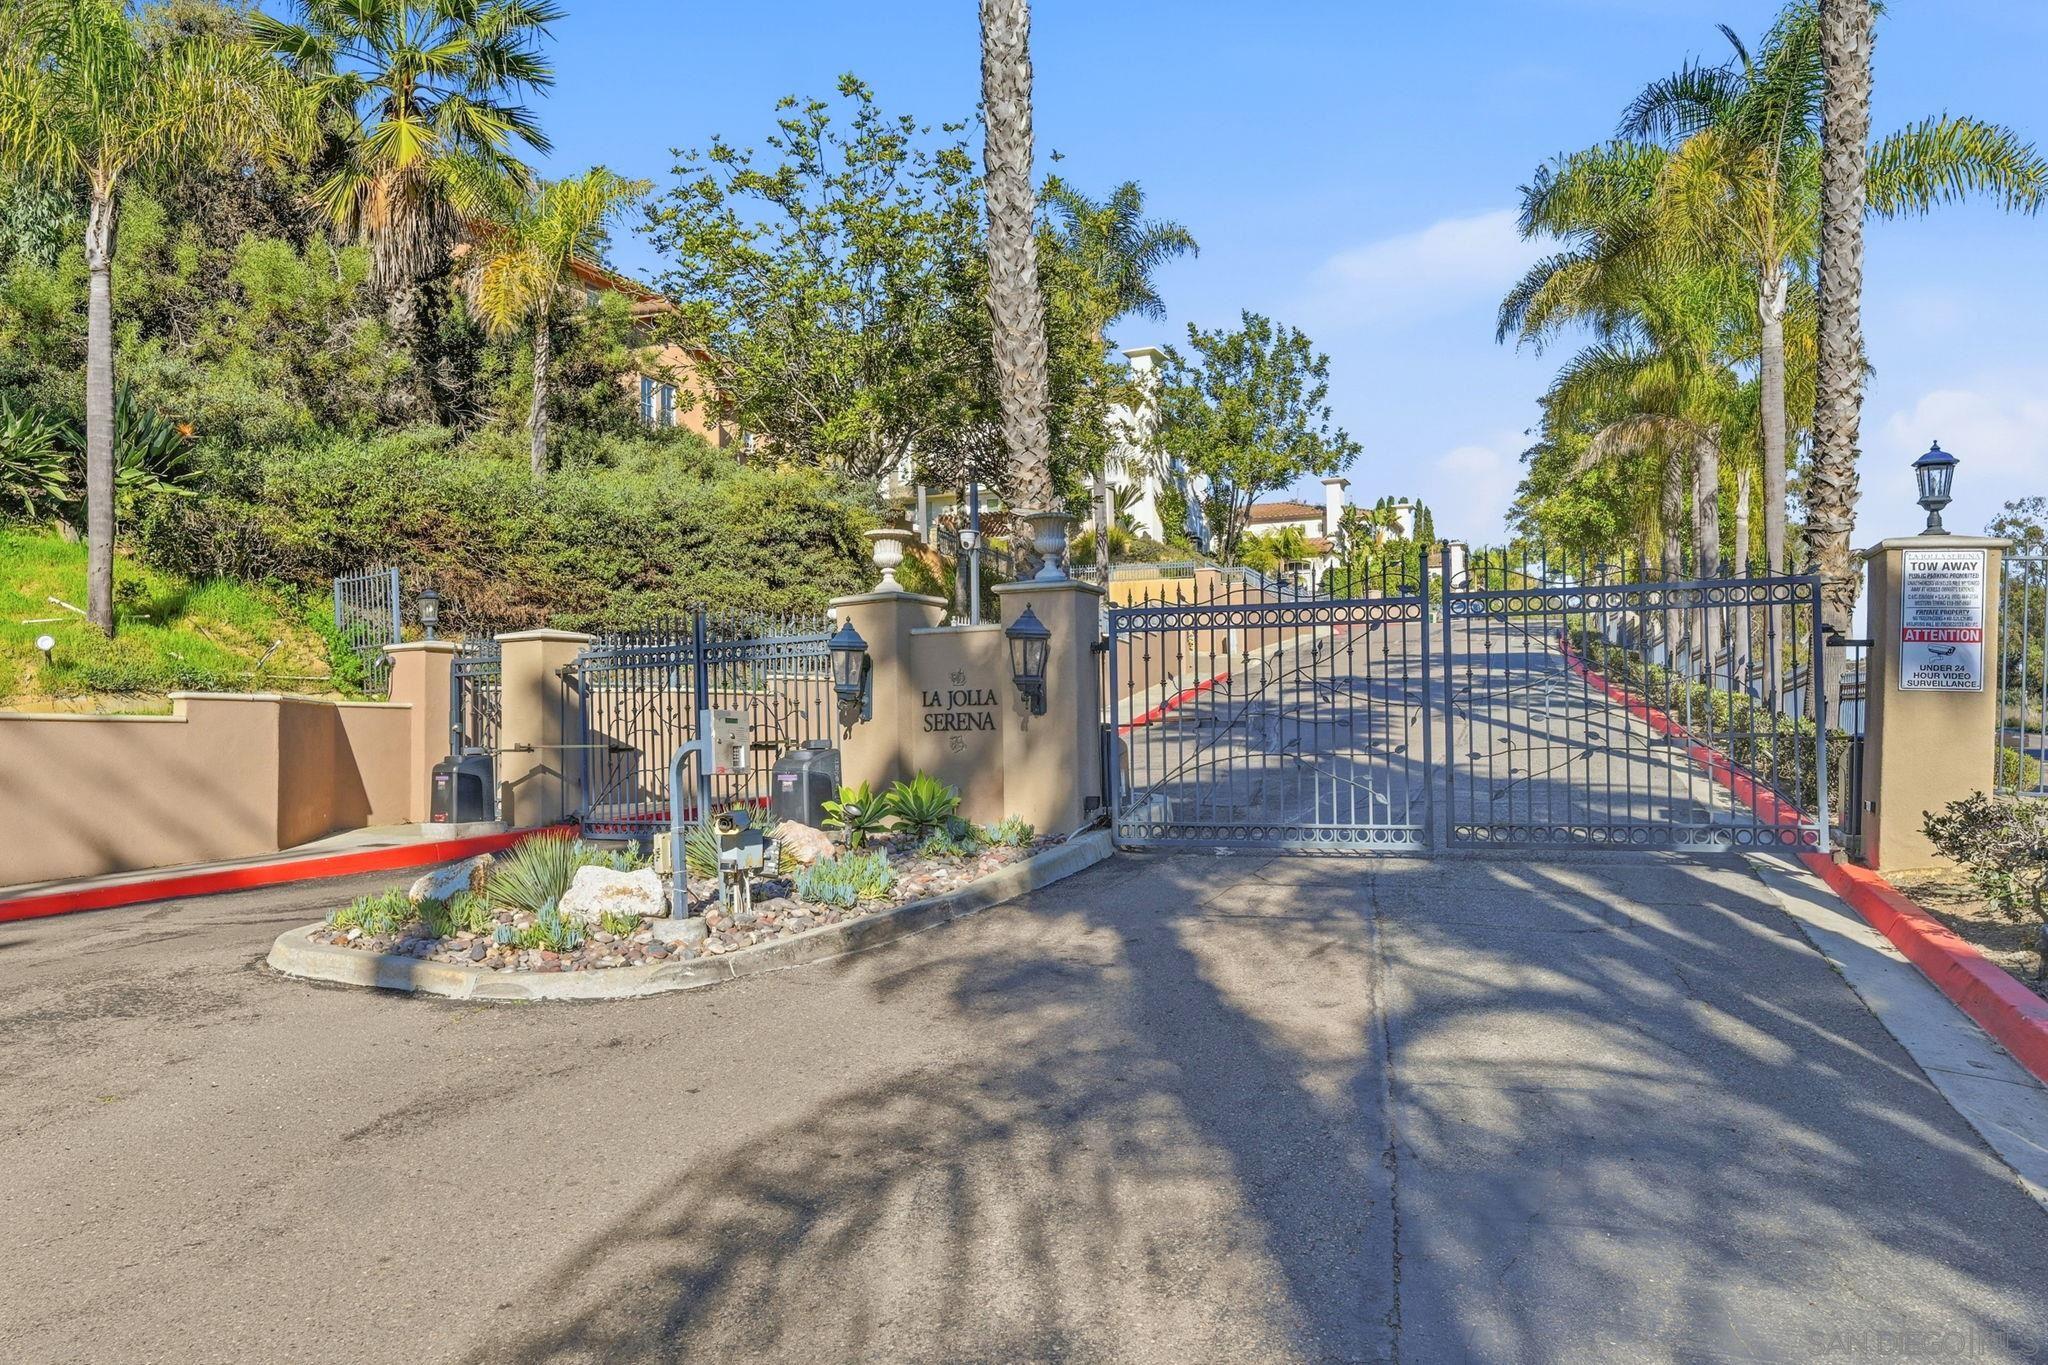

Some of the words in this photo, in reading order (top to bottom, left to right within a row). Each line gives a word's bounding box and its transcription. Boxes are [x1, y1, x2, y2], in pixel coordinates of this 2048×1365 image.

[1910, 562, 1938, 571] TOW
[1942, 562, 1978, 571] AWAY
[1905, 629, 1980, 641] ATTENTION
[922, 690, 942, 707] LA
[946, 689, 999, 710] JOLLA
[923, 711, 997, 732] SERENA
